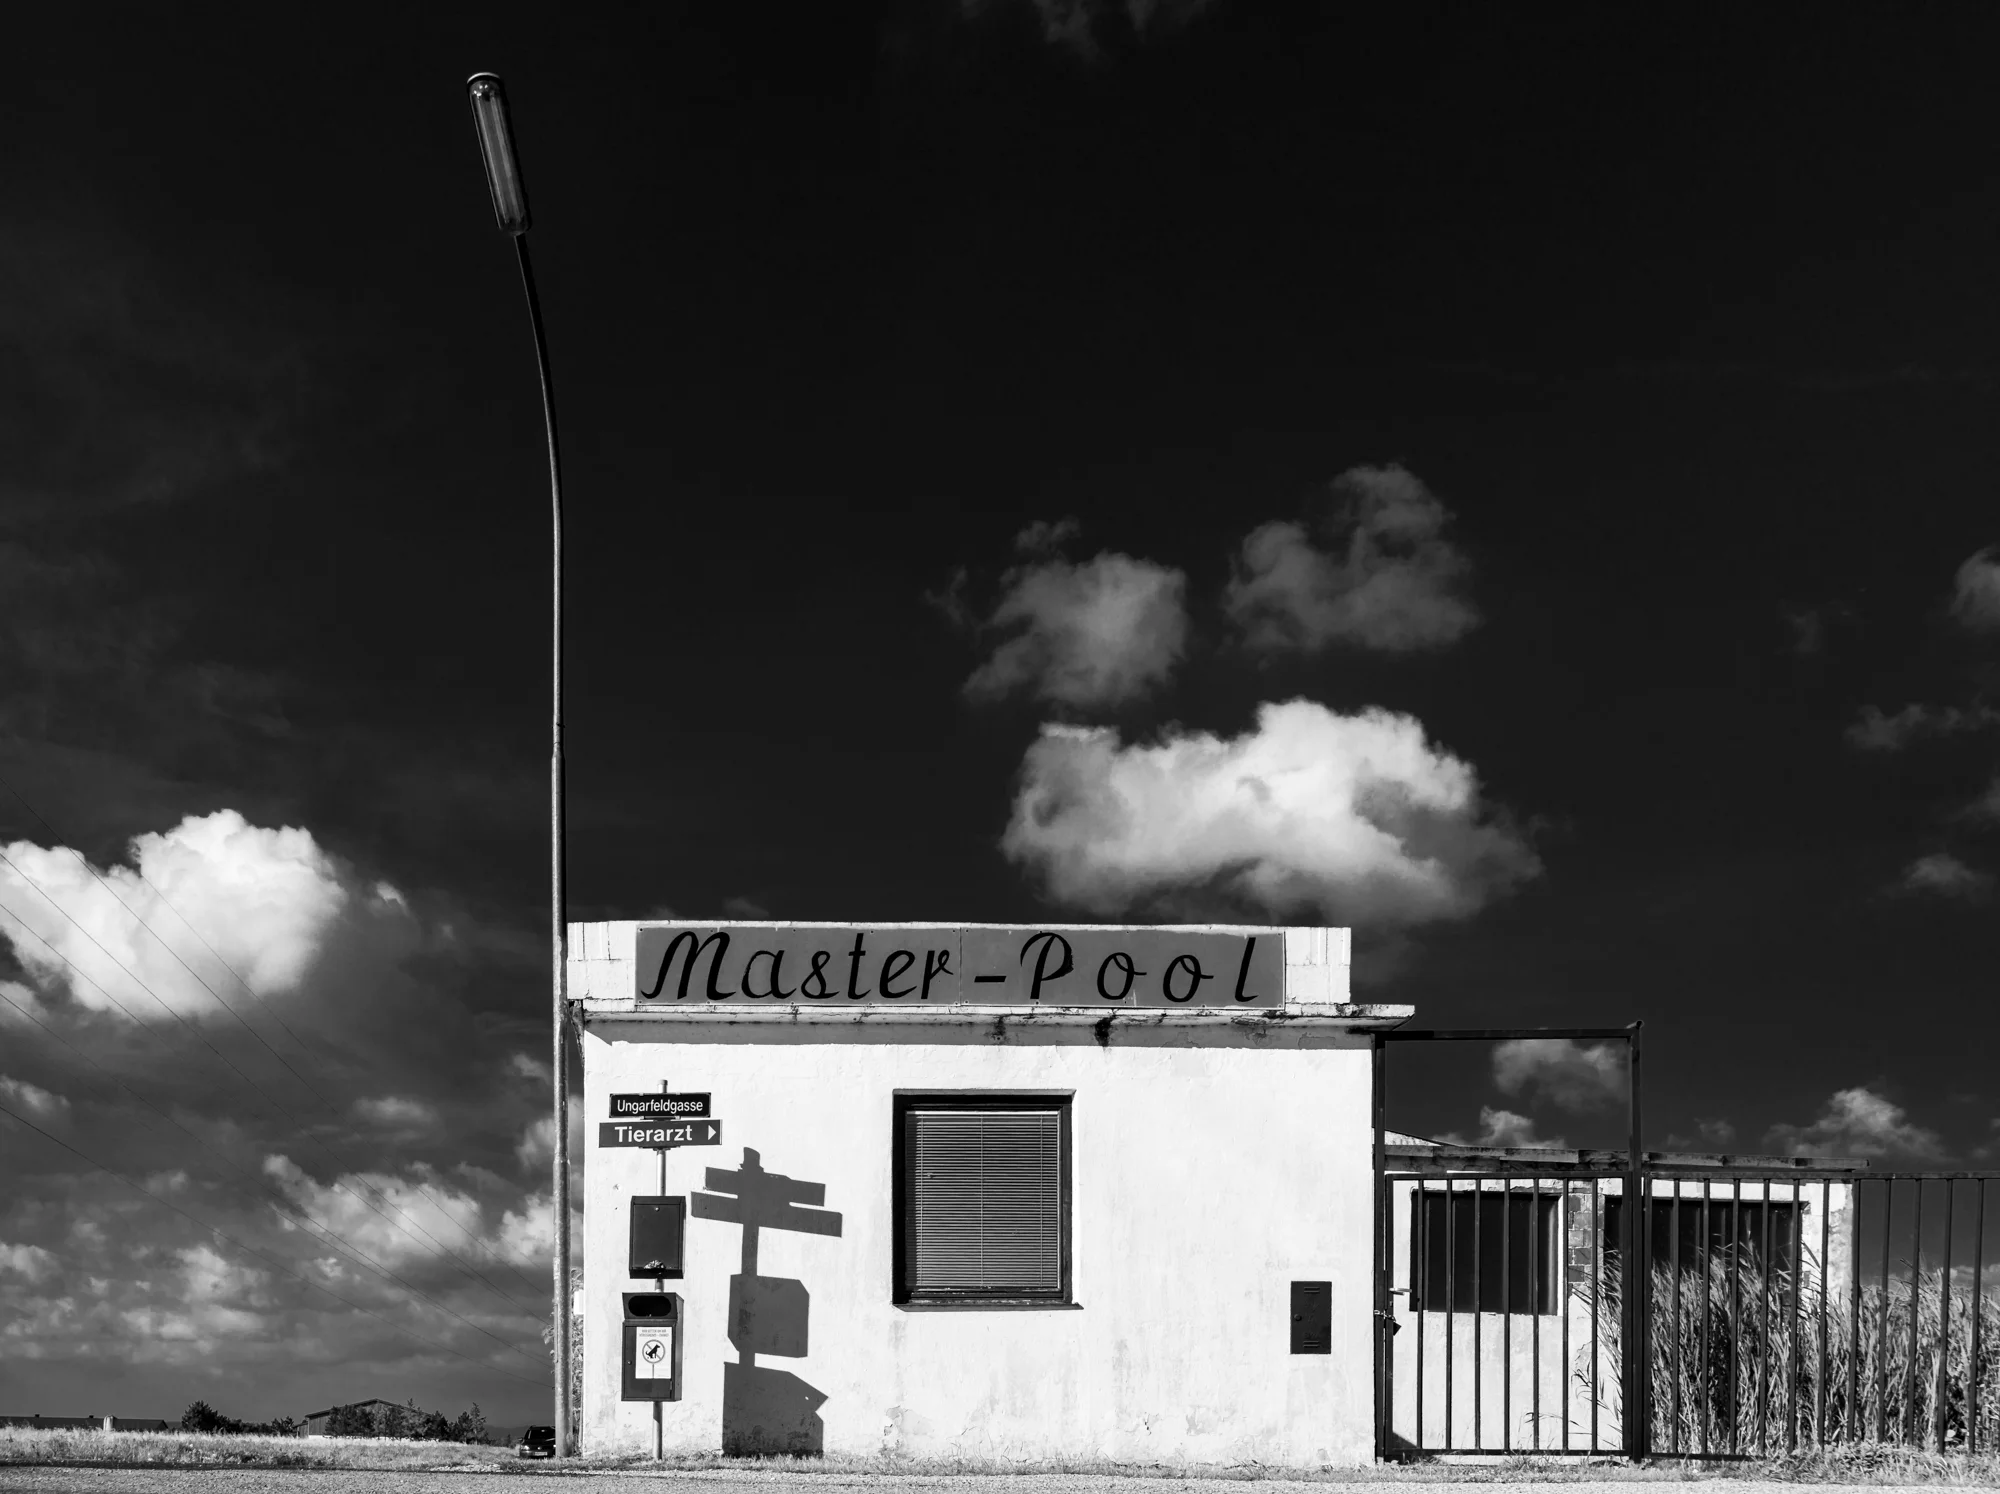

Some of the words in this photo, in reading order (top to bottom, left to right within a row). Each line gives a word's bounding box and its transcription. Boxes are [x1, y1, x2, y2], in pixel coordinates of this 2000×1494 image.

[641, 931, 954, 1000] Master
[1020, 932, 1259, 1002] Pool
[616, 1099, 704, 1115] Ungarfeldgasse
[614, 1124, 693, 1143] Tierarzt
